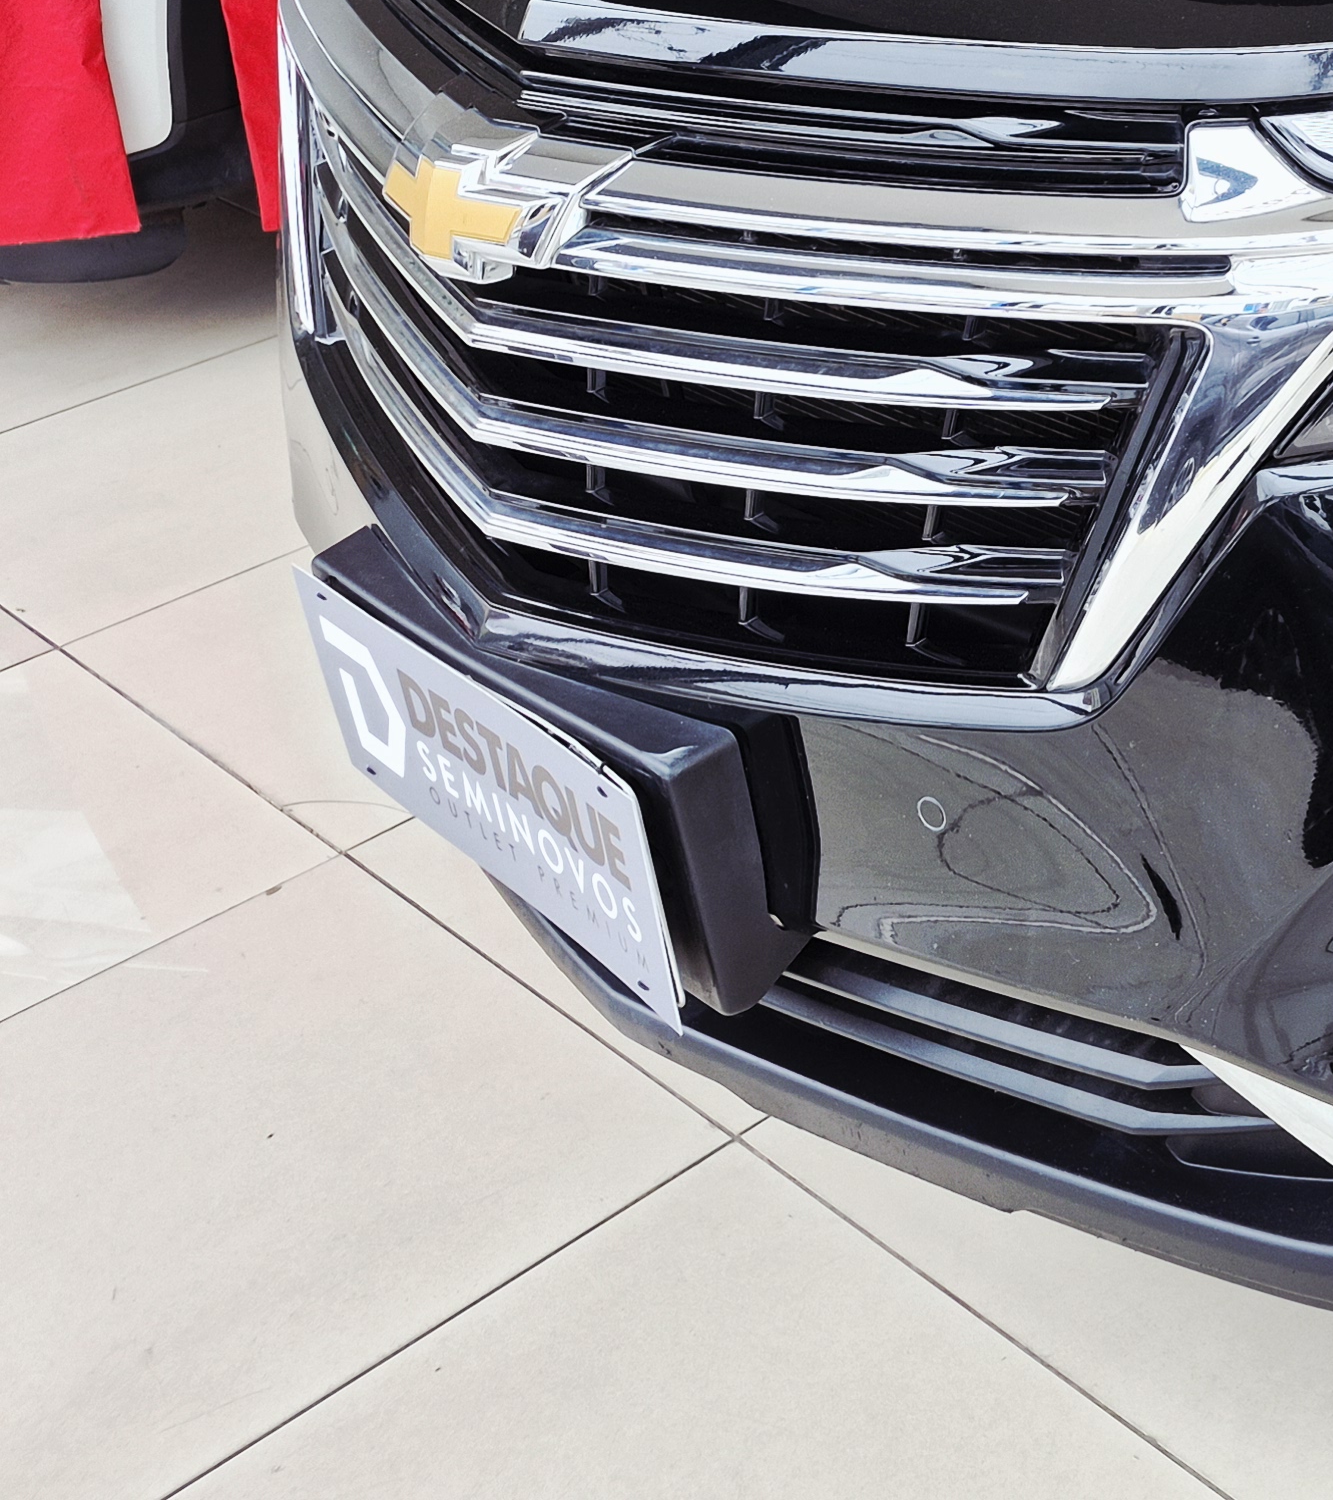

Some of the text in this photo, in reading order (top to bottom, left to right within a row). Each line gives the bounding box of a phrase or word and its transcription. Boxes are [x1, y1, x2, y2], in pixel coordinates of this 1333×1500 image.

[396, 668, 633, 891] DESTAQUE
[416, 741, 643, 944] SEMINOVOS
[429, 786, 650, 974] OUTLET PREMIUM
